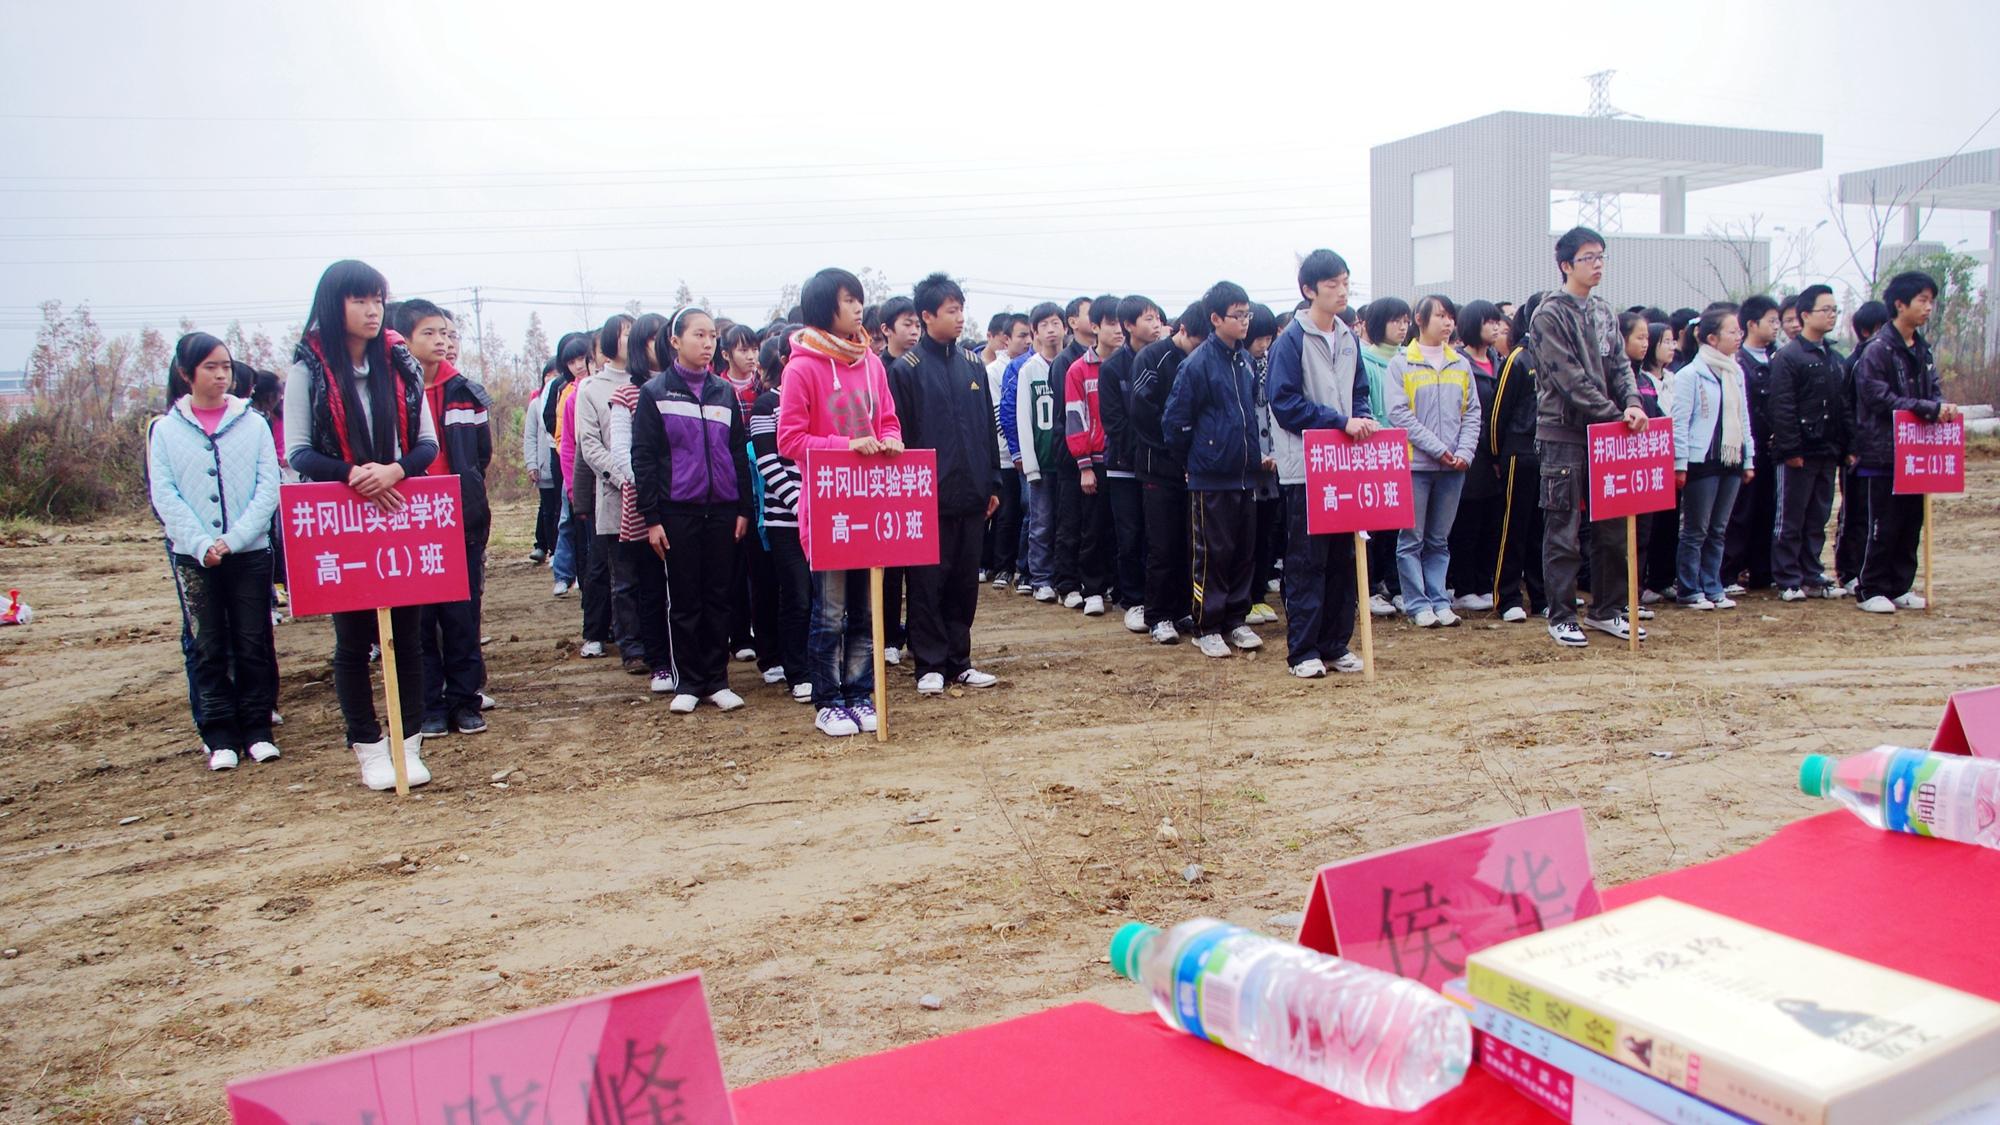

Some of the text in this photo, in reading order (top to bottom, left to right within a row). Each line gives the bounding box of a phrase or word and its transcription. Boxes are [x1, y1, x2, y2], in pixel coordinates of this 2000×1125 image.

[1594, 430, 1670, 463] 井冈山实验学校
[1898, 422, 1961, 445] 井冈山实验学校
[1311, 442, 1405, 472] 井冈山实验学校
[817, 464, 932, 499] 井冈山实验学校
[292, 493, 456, 538] 井冈山实验学校
[1918, 782, 1936, 825] 润田
